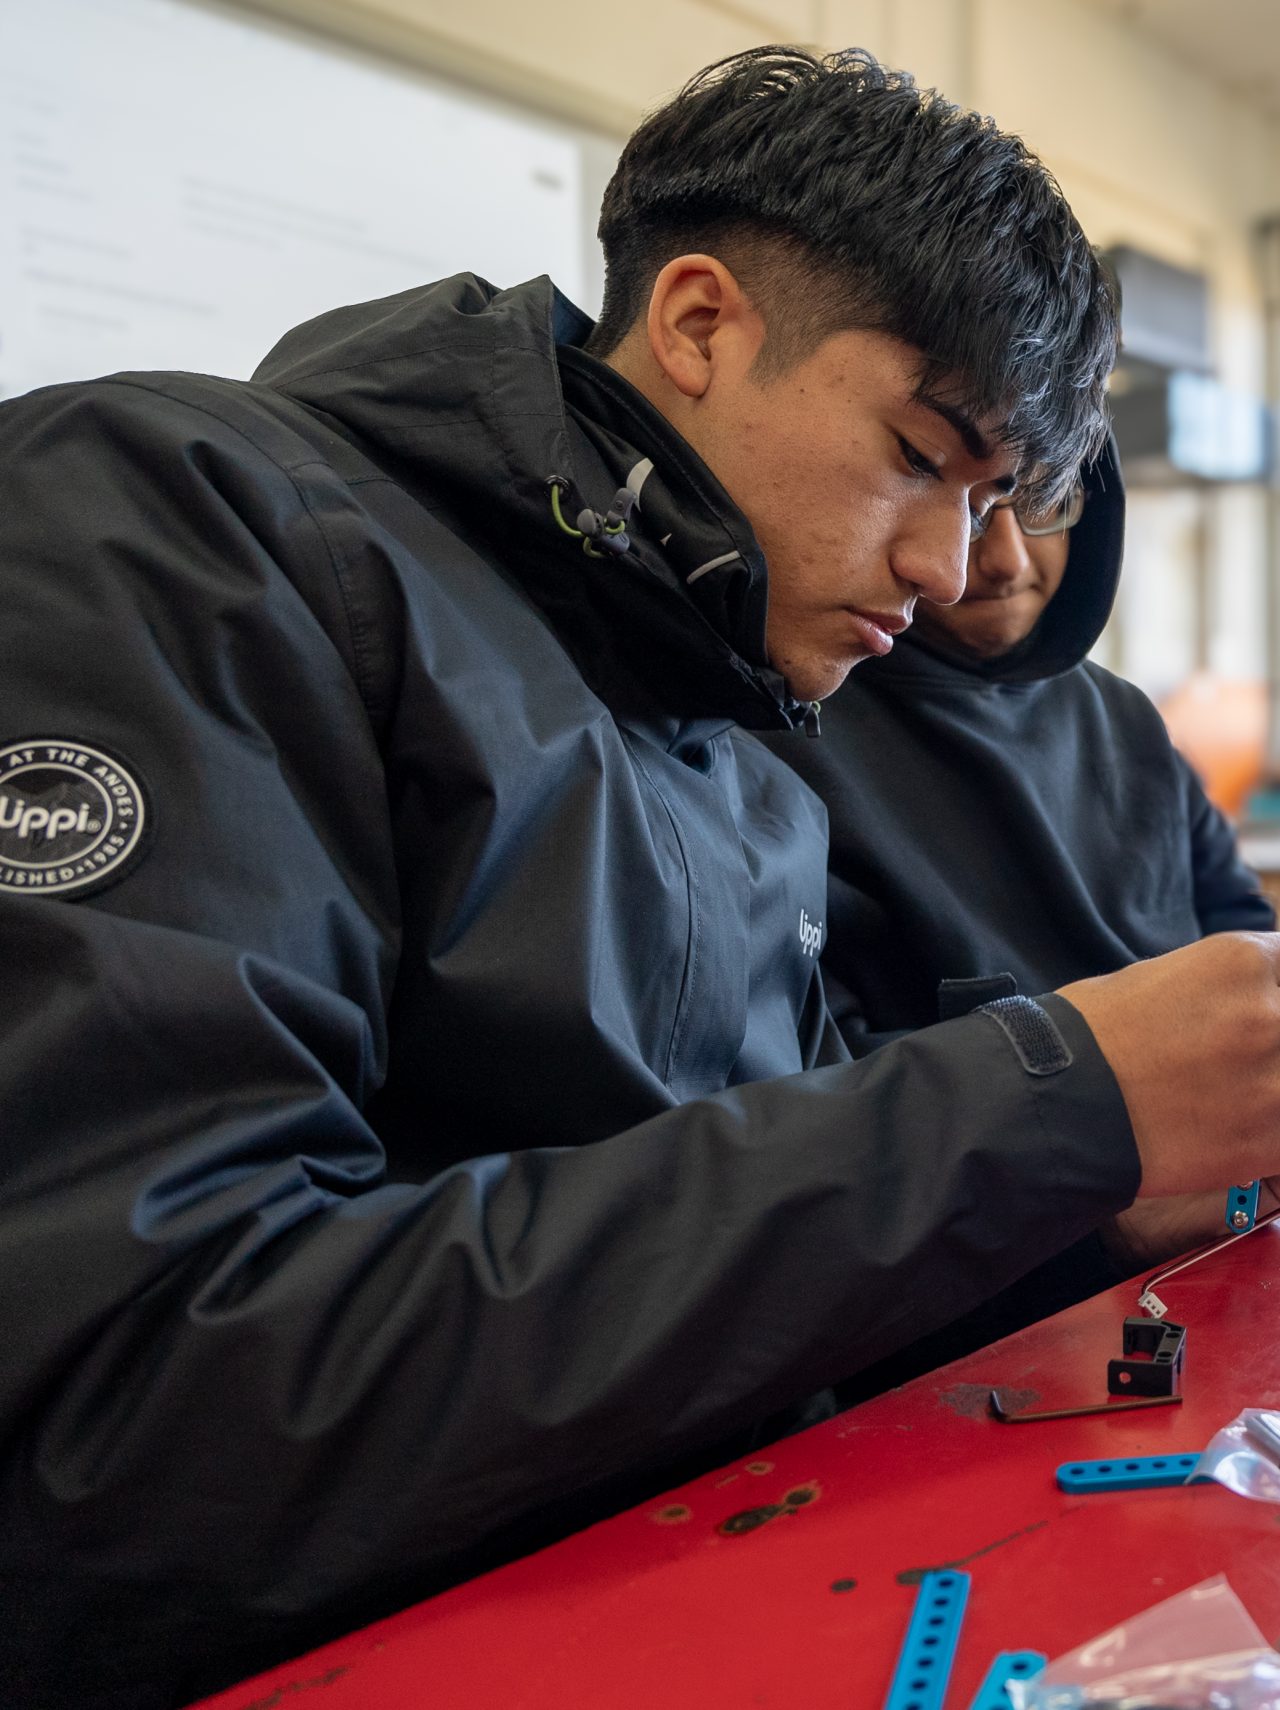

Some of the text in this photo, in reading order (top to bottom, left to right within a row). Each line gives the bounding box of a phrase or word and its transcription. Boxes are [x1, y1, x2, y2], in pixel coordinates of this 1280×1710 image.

[9, 748, 134, 817] AT THE ANDES
